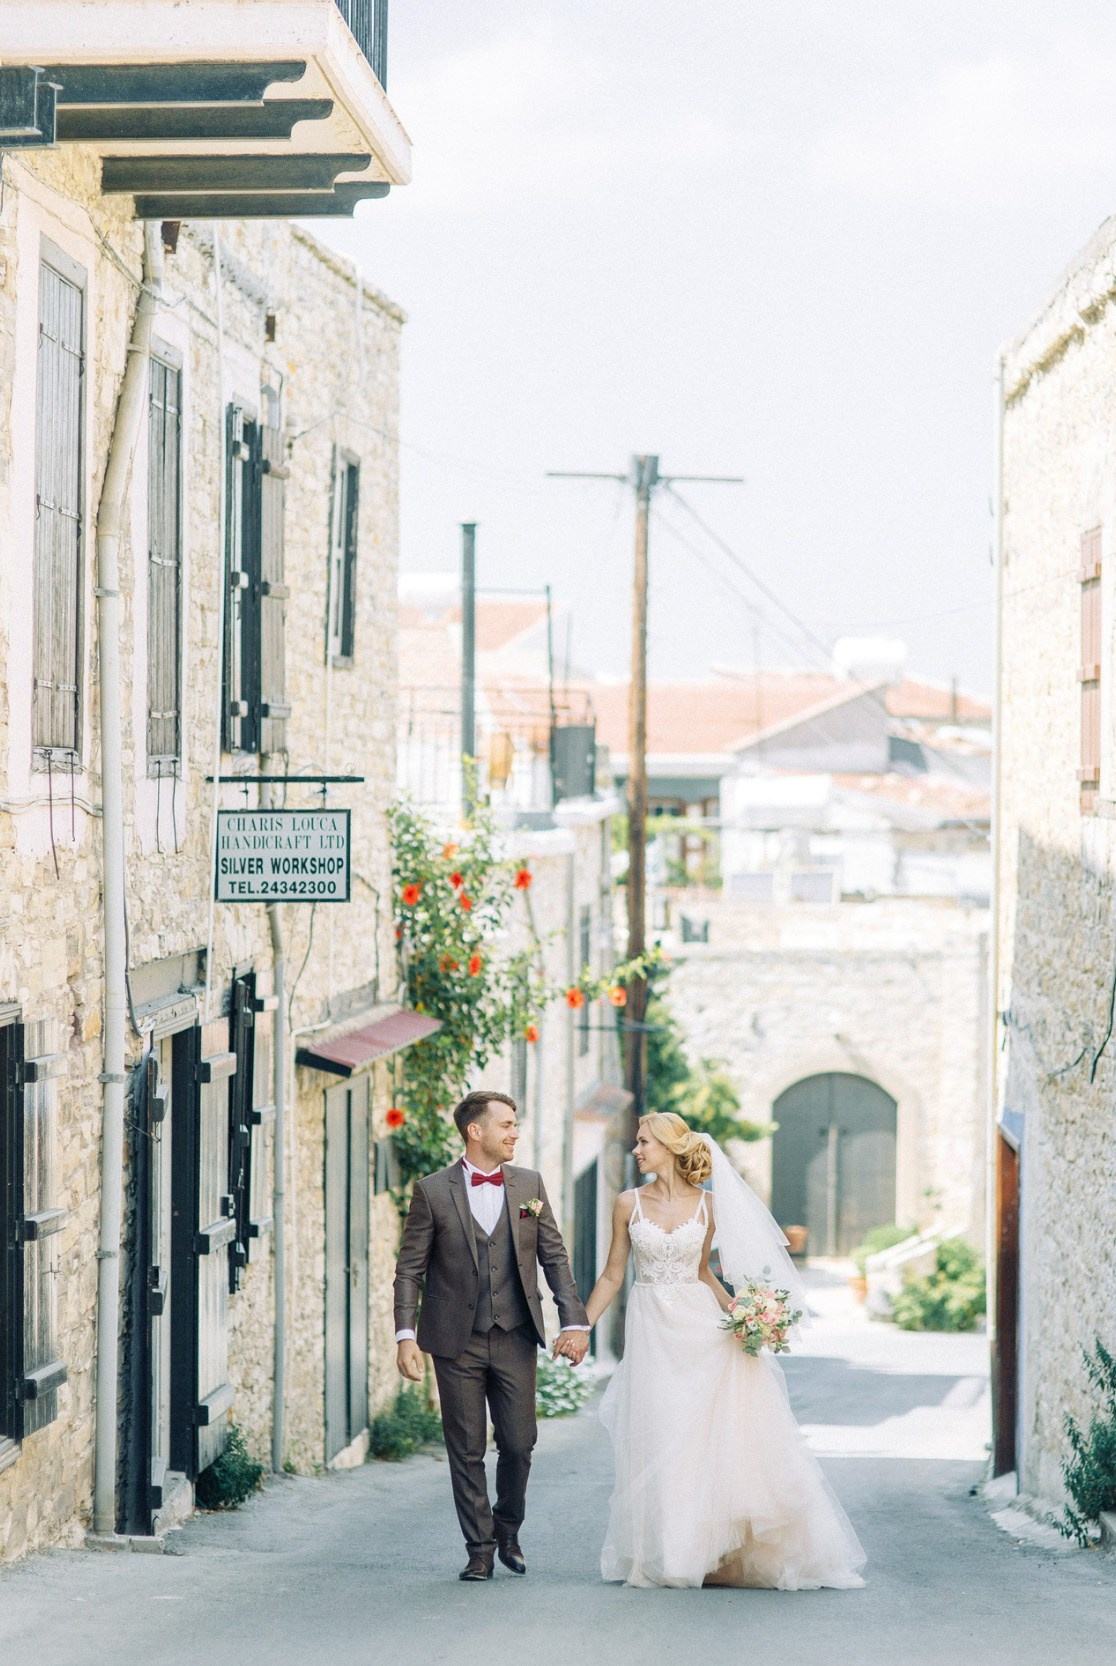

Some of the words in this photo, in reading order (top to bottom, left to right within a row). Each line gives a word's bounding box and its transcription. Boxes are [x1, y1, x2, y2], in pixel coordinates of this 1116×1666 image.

[227, 817, 283, 831] CHARIS
[292, 817, 337, 831] LOUCA
[221, 835, 311, 850] HANDICRAFT
[320, 835, 345, 849] LTD
[221, 857, 264, 875] SILVER
[270, 857, 344, 874] WORKSHOP
